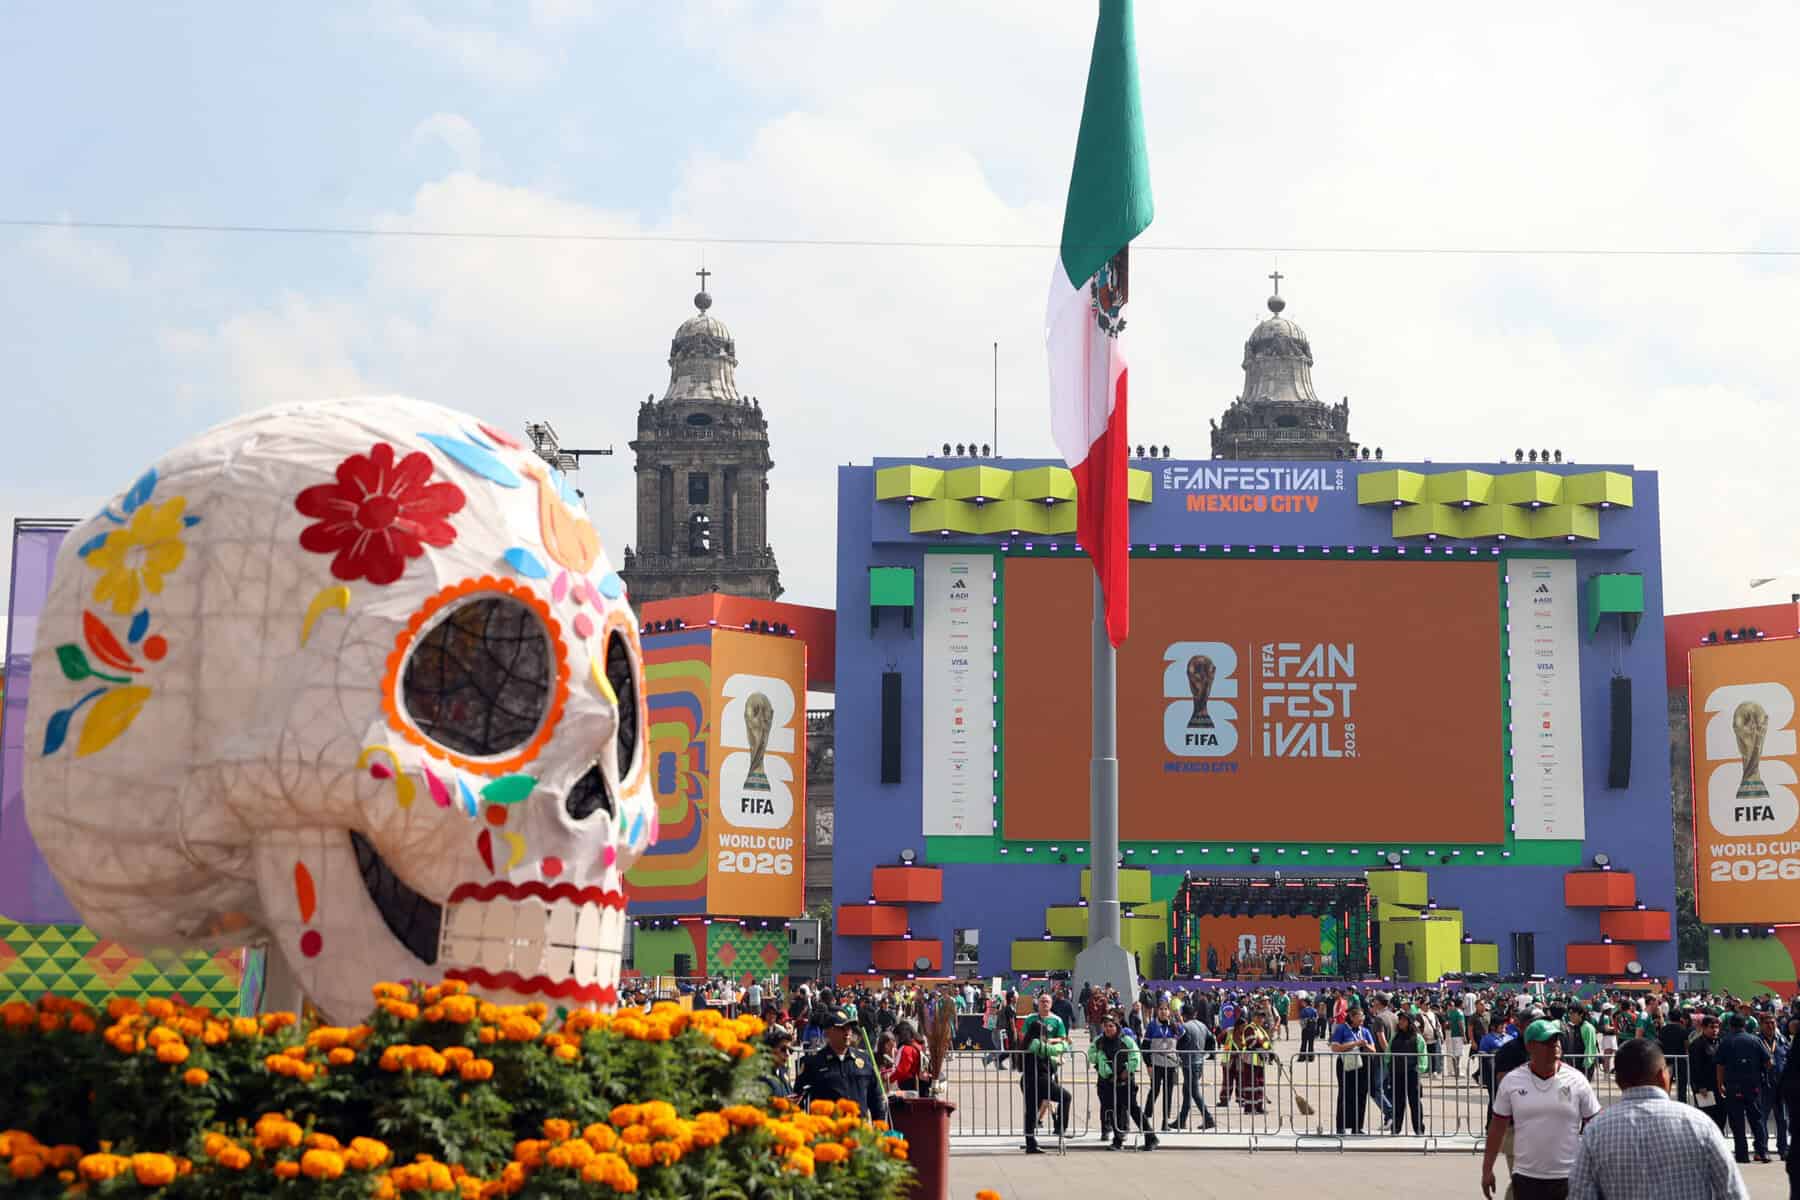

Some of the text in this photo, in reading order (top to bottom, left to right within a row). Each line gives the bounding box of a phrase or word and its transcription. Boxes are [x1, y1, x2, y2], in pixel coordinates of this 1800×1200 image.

[1163, 467, 1173, 489] FIFA
[1186, 494, 1267, 513] MEXICO
[1263, 643, 1275, 677] FIFA
[1278, 643, 1355, 677] FAN
[1262, 683, 1358, 718] FEST
[1185, 733, 1219, 746] FIFA
[1344, 722, 1356, 758] 2026
[741, 798, 774, 815] FIFA
[1734, 805, 1775, 822] FIFA
[719, 834, 793, 850] WORLD CUP
[1710, 841, 1800, 857] WORLD CUP
[718, 851, 793, 875] 2026
[1711, 858, 1800, 882] 2026
